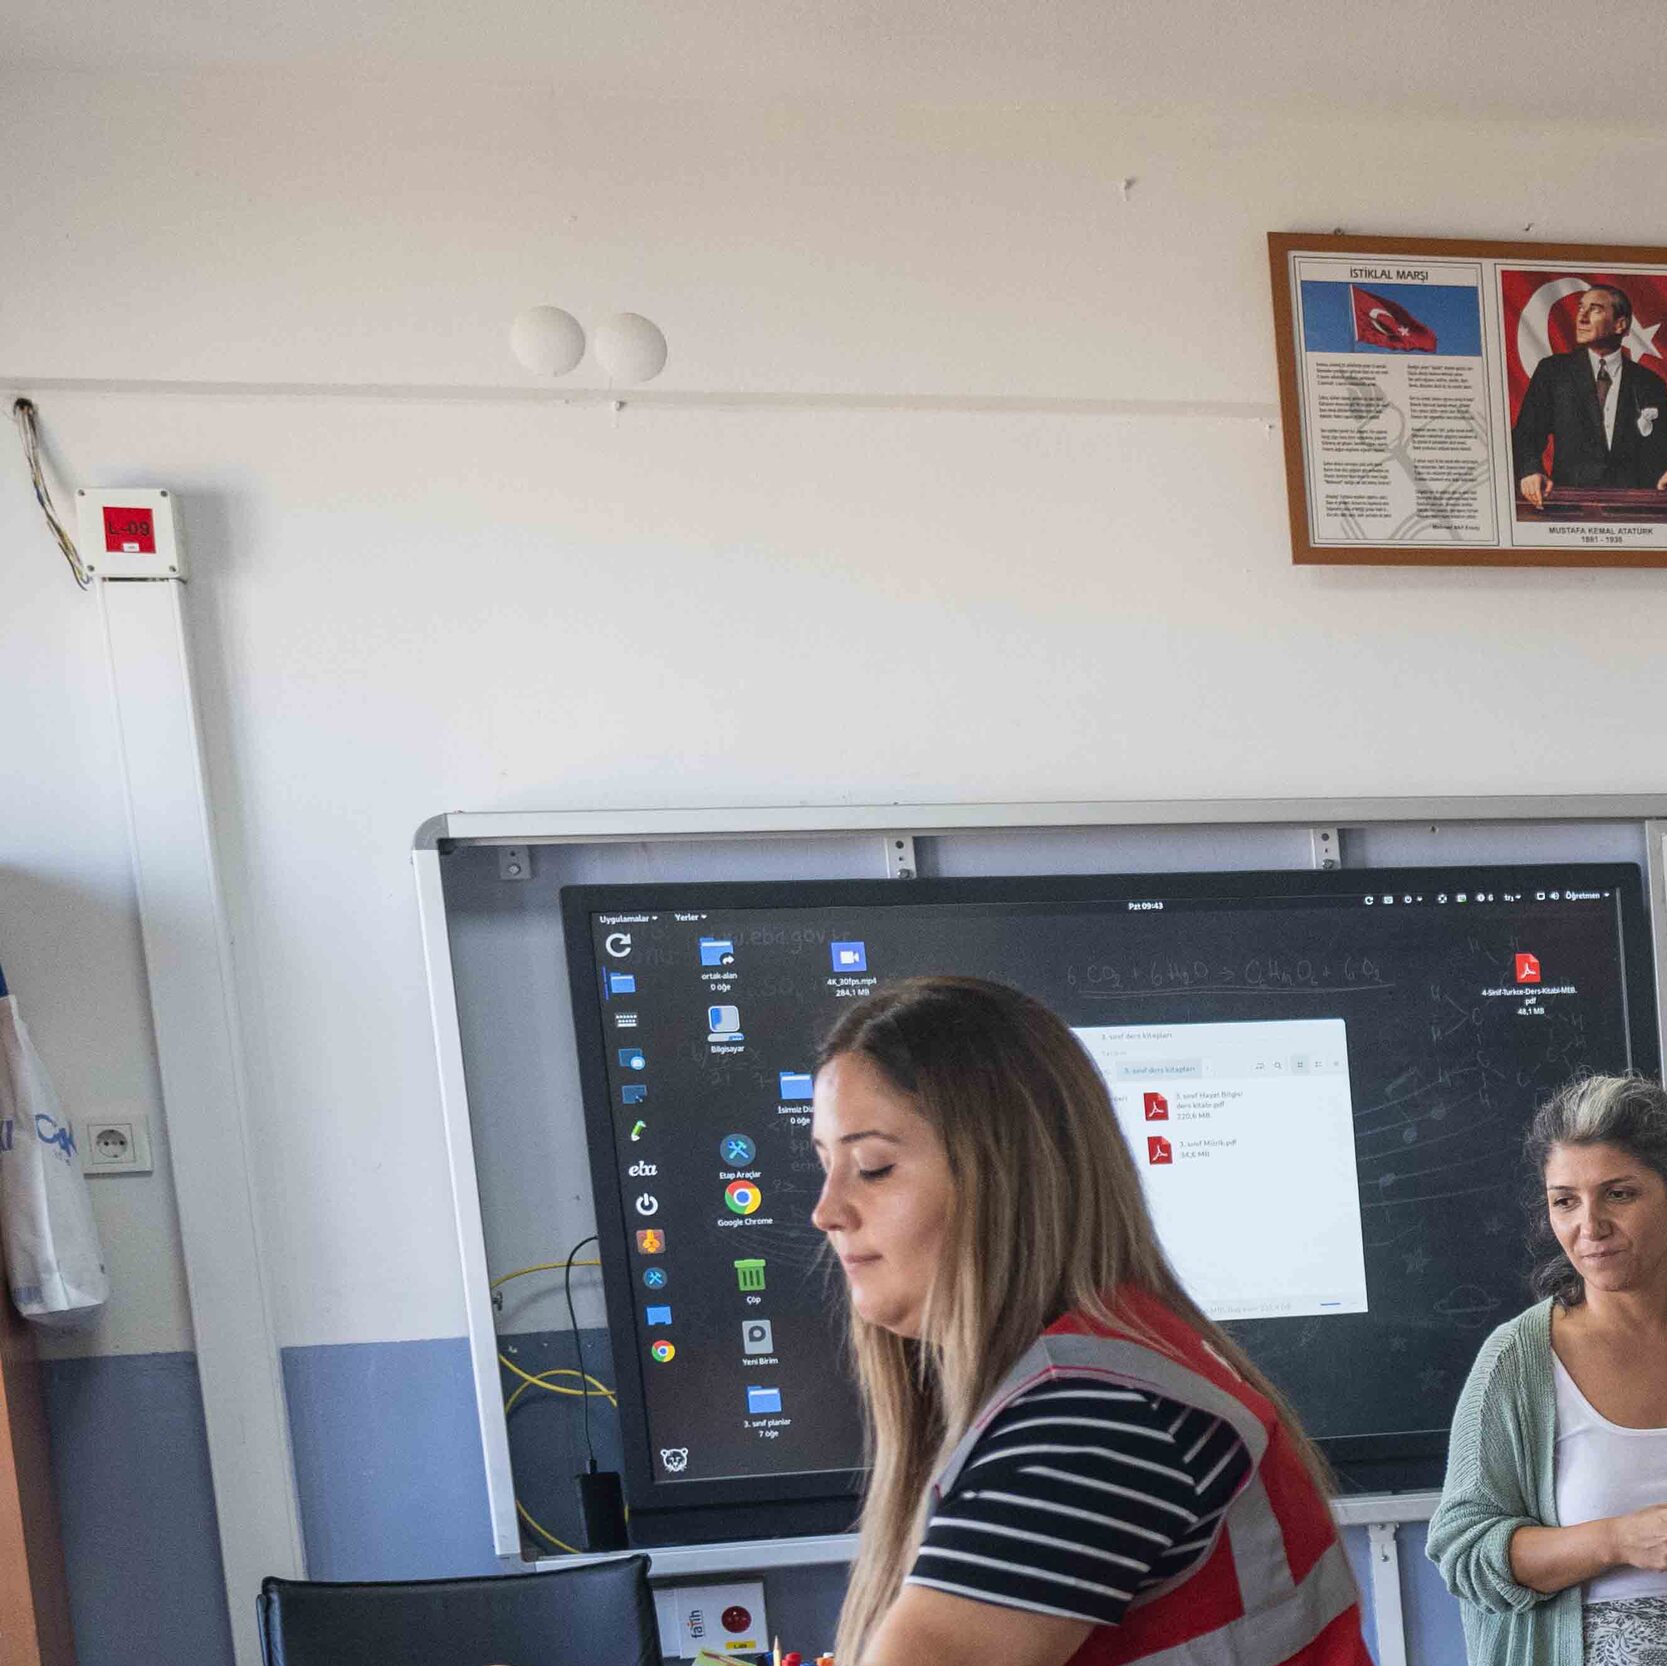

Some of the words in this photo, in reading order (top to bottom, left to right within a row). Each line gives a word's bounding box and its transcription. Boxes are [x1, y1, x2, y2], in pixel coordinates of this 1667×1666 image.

[1350, 267, 1394, 280] İSTİKLAL
[1396, 271, 1430, 283] MARŞI
[1548, 527, 1586, 535] MUSTAFA
[1588, 527, 1616, 535] KEMAL
[1565, 890, 1600, 901] Öğretmen
[1128, 902, 1141, 911] Pzt
[1142, 901, 1164, 911] 09:43
[600, 914, 650, 924] Uygulamalar
[675, 912, 699, 922] Yerler
[701, 972, 738, 980] ortak-alan
[827, 976, 877, 987] 4K_30fps.mp4
[717, 983, 731, 993] öğe
[857, 988, 870, 997] MB
[1525, 997, 1537, 1006] pdf
[1533, 1007, 1545, 1015] MB
[711, 1044, 745, 1055] Bilgisayar
[778, 1105, 802, 1114] İsimsiz
[797, 1117, 810, 1127] öğe
[629, 1160, 658, 1177] eba
[719, 1171, 736, 1181] Etap
[737, 1170, 762, 1180] Araçlar
[718, 1217, 744, 1228] Google
[746, 1216, 774, 1226] Chrome
[746, 1295, 762, 1306] Çöp
[742, 1358, 758, 1367] Yeni
[759, 1357, 778, 1366] Birim
[752, 1418, 767, 1428] sınıf
[768, 1418, 791, 1429] planlar
[765, 1430, 779, 1439] öğe
[687, 1609, 705, 1639] fatih
